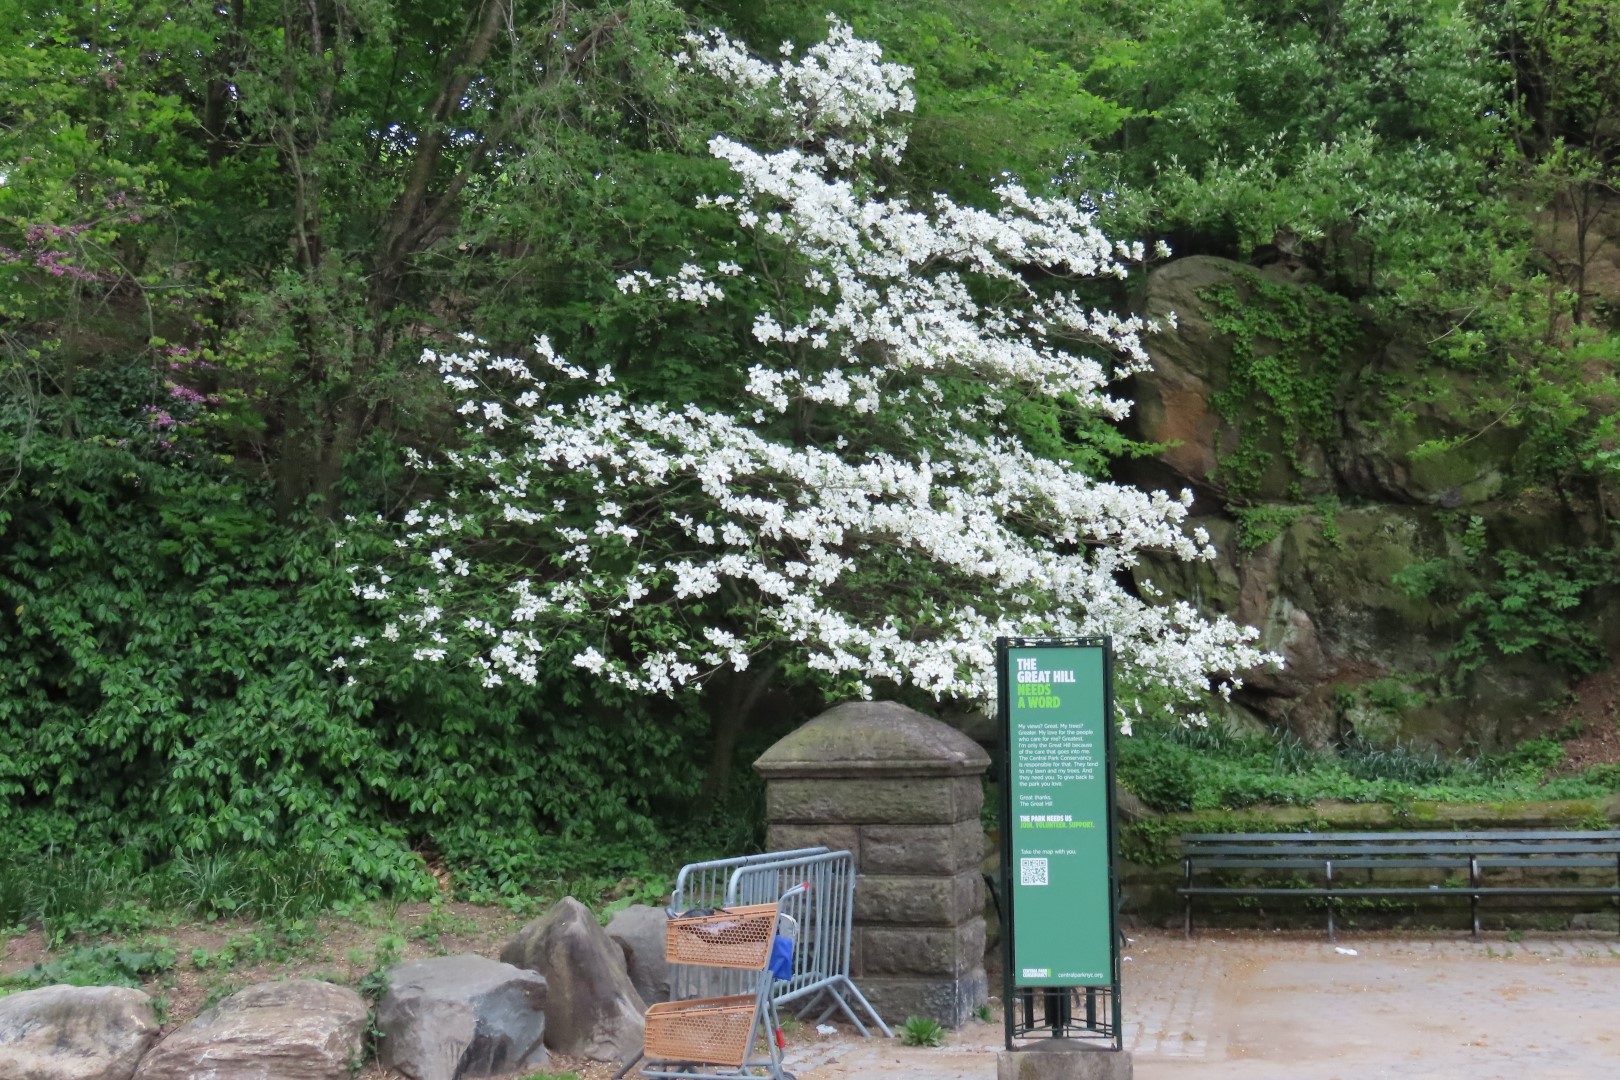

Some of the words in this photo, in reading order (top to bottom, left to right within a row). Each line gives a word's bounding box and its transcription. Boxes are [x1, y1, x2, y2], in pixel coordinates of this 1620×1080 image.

[1017, 658, 1037, 670] THE
[1017, 671, 1050, 683] GREAT
[1053, 671, 1076, 683] HILL
[1018, 684, 1051, 695] NEEDS
[1018, 696, 1026, 708] A
[1028, 696, 1060, 708] WORD
